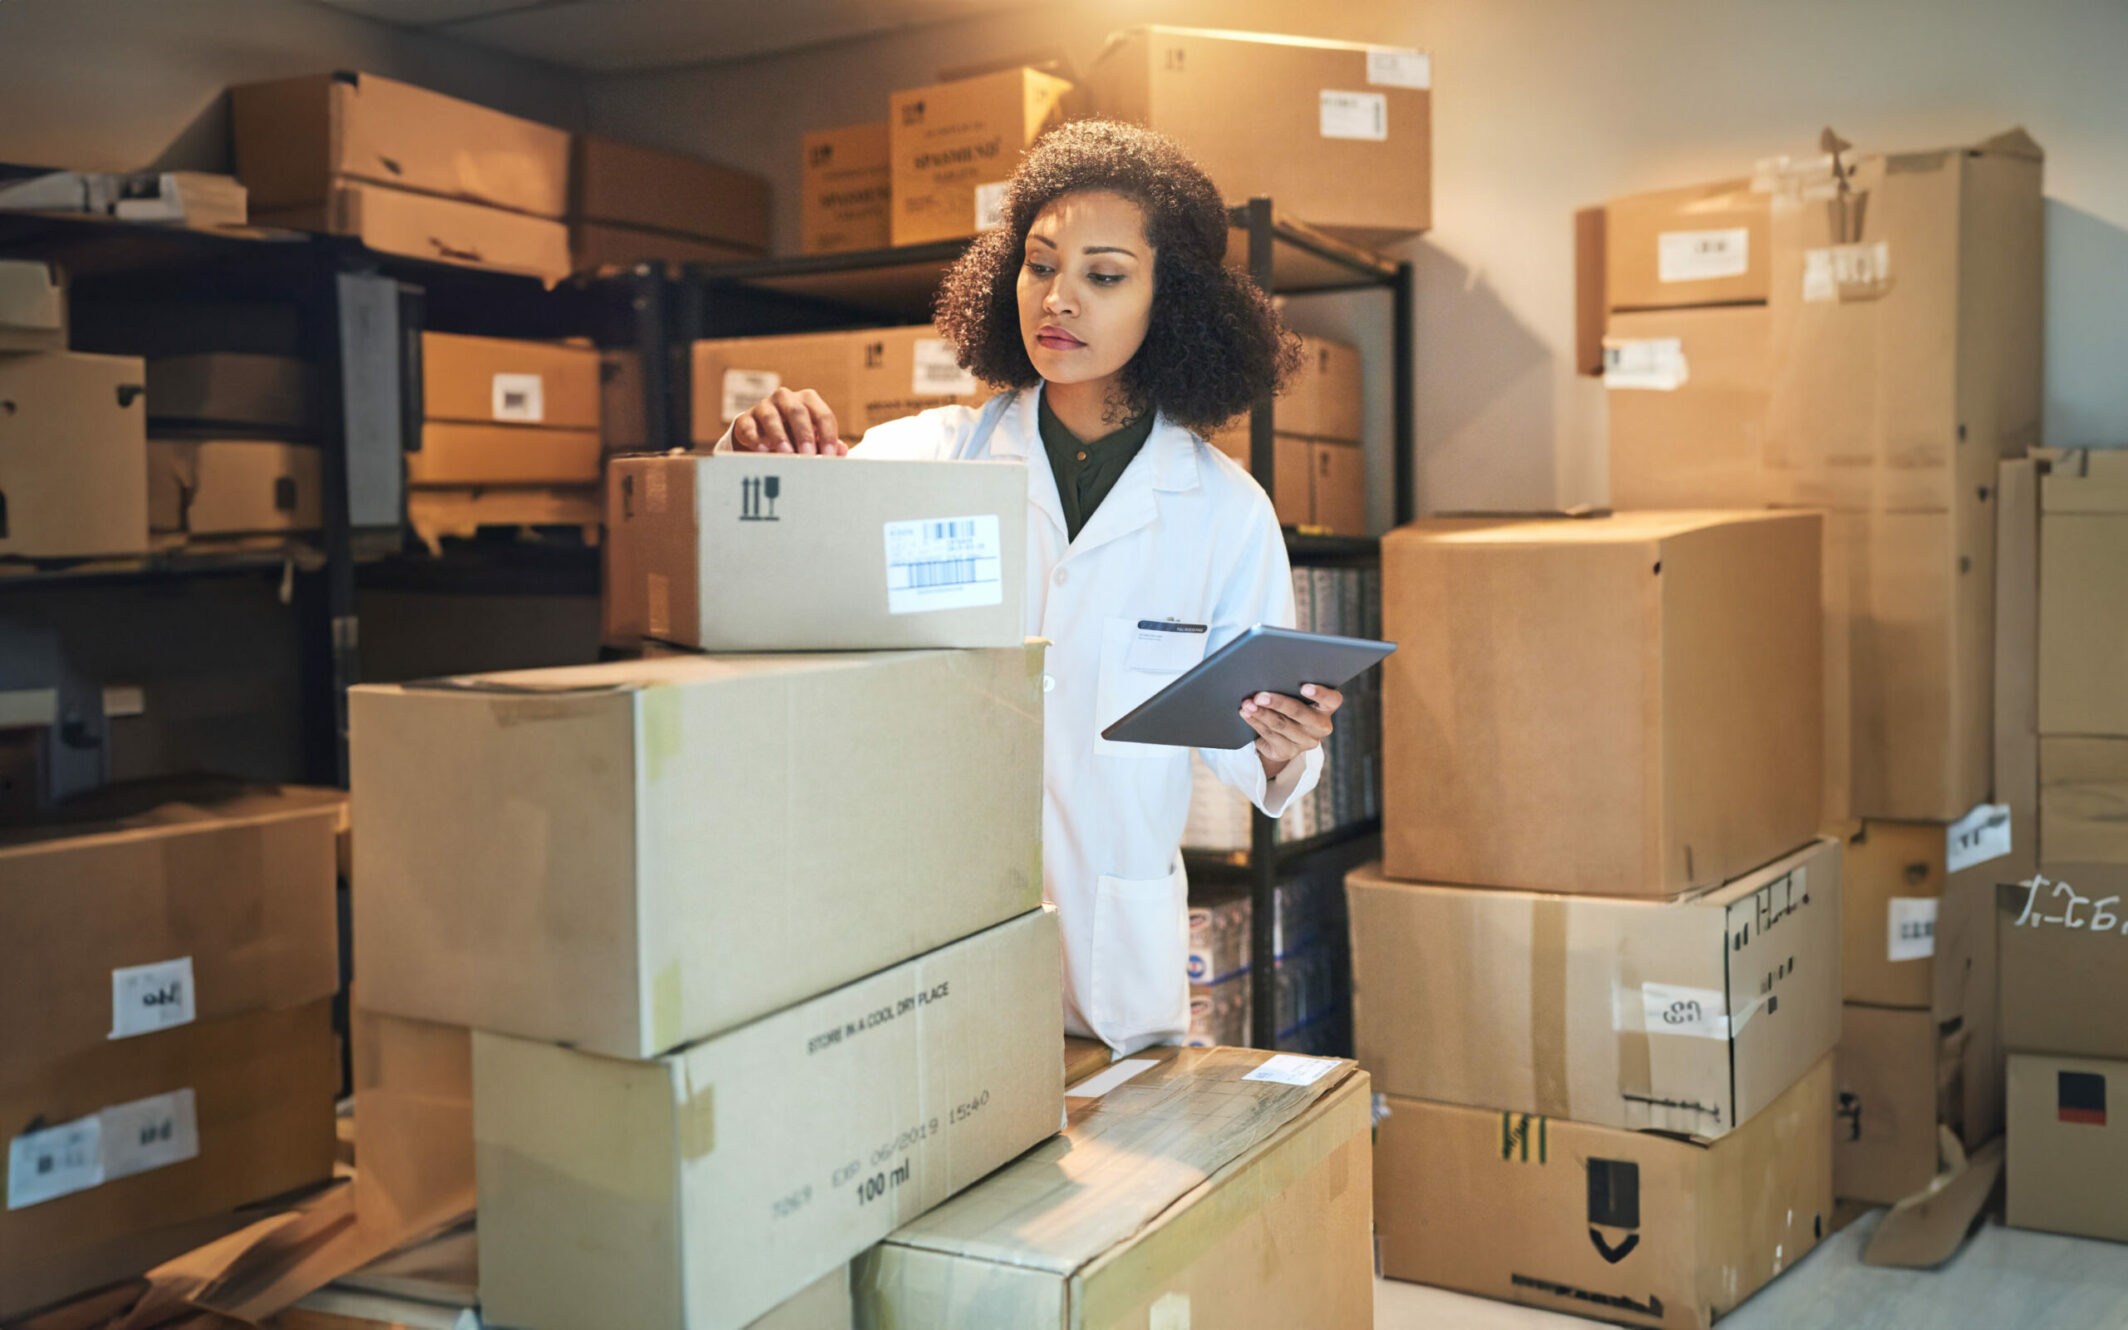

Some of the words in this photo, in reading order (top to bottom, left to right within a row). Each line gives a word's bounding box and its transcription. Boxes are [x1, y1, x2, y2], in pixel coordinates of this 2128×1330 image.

[807, 1027, 842, 1055] STORE
[846, 1022, 856, 1037] IN
[858, 1017, 866, 1031] A
[867, 1005, 895, 1028] COOL
[896, 996, 915, 1016] DRY
[917, 981, 949, 1007] PLACE
[870, 1117, 939, 1166] 06/2019
[949, 1089, 990, 1125] 15:40
[856, 1172, 886, 1206] 100
[890, 1157, 910, 1189] ml
